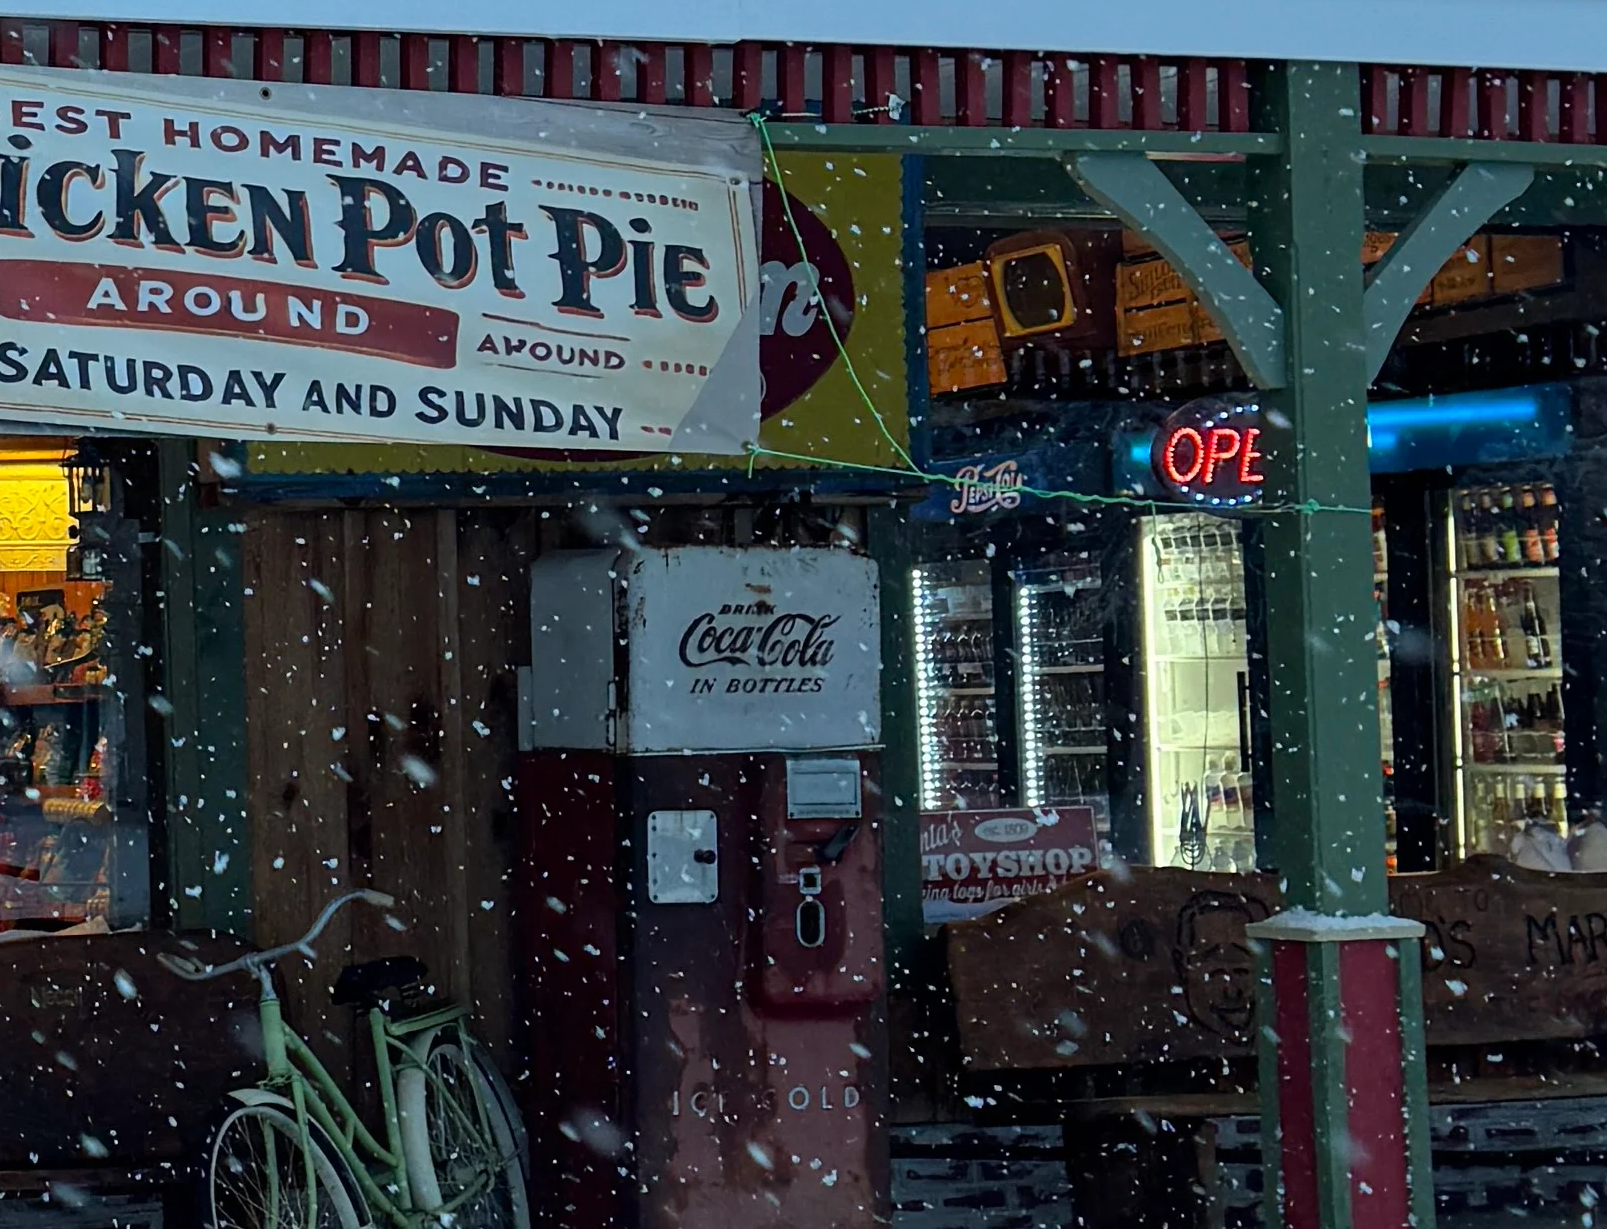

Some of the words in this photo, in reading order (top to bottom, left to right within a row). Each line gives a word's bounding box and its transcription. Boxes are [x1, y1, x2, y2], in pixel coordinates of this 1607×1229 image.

[162, 116, 511, 193] HOMEMADE
[85, 276, 371, 336] AROUND
[303, 379, 398, 418] AND
[415, 386, 625, 441] SUNDAY
[1163, 426, 1264, 485] OPE
[678, 612, 843, 668] Coca-Cola
[690, 677, 718, 695] IN
[725, 677, 827, 695] BOTTLES
[921, 847, 1093, 882] TOYSHOP
